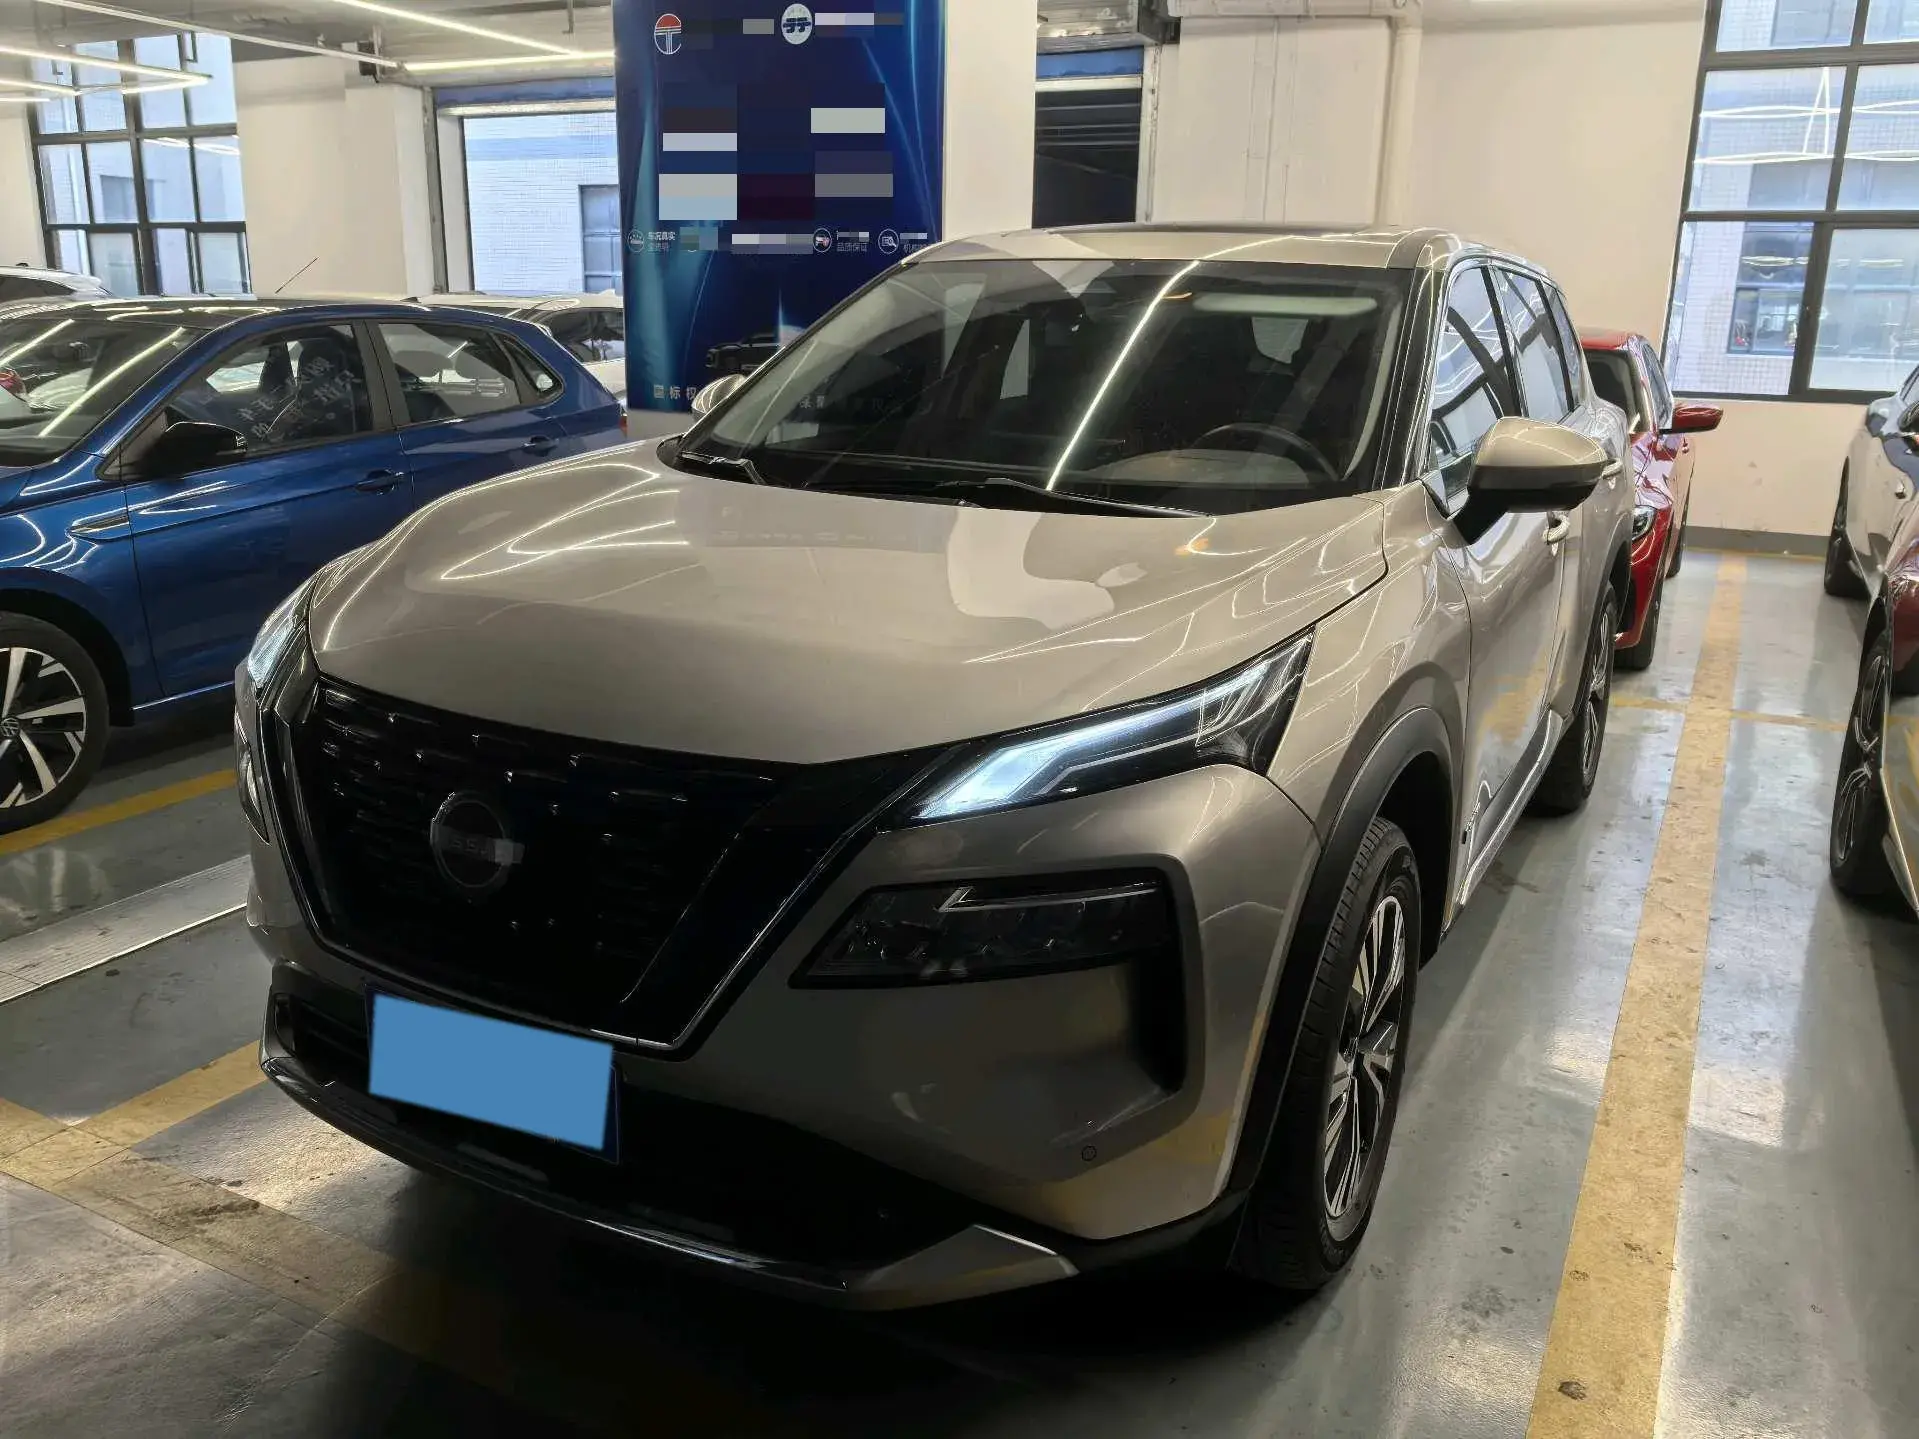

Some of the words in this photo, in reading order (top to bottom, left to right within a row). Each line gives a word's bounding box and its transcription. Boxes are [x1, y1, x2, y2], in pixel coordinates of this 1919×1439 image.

[648, 232, 676, 240] 车况真实
[837, 242, 867, 252] 品质保证
